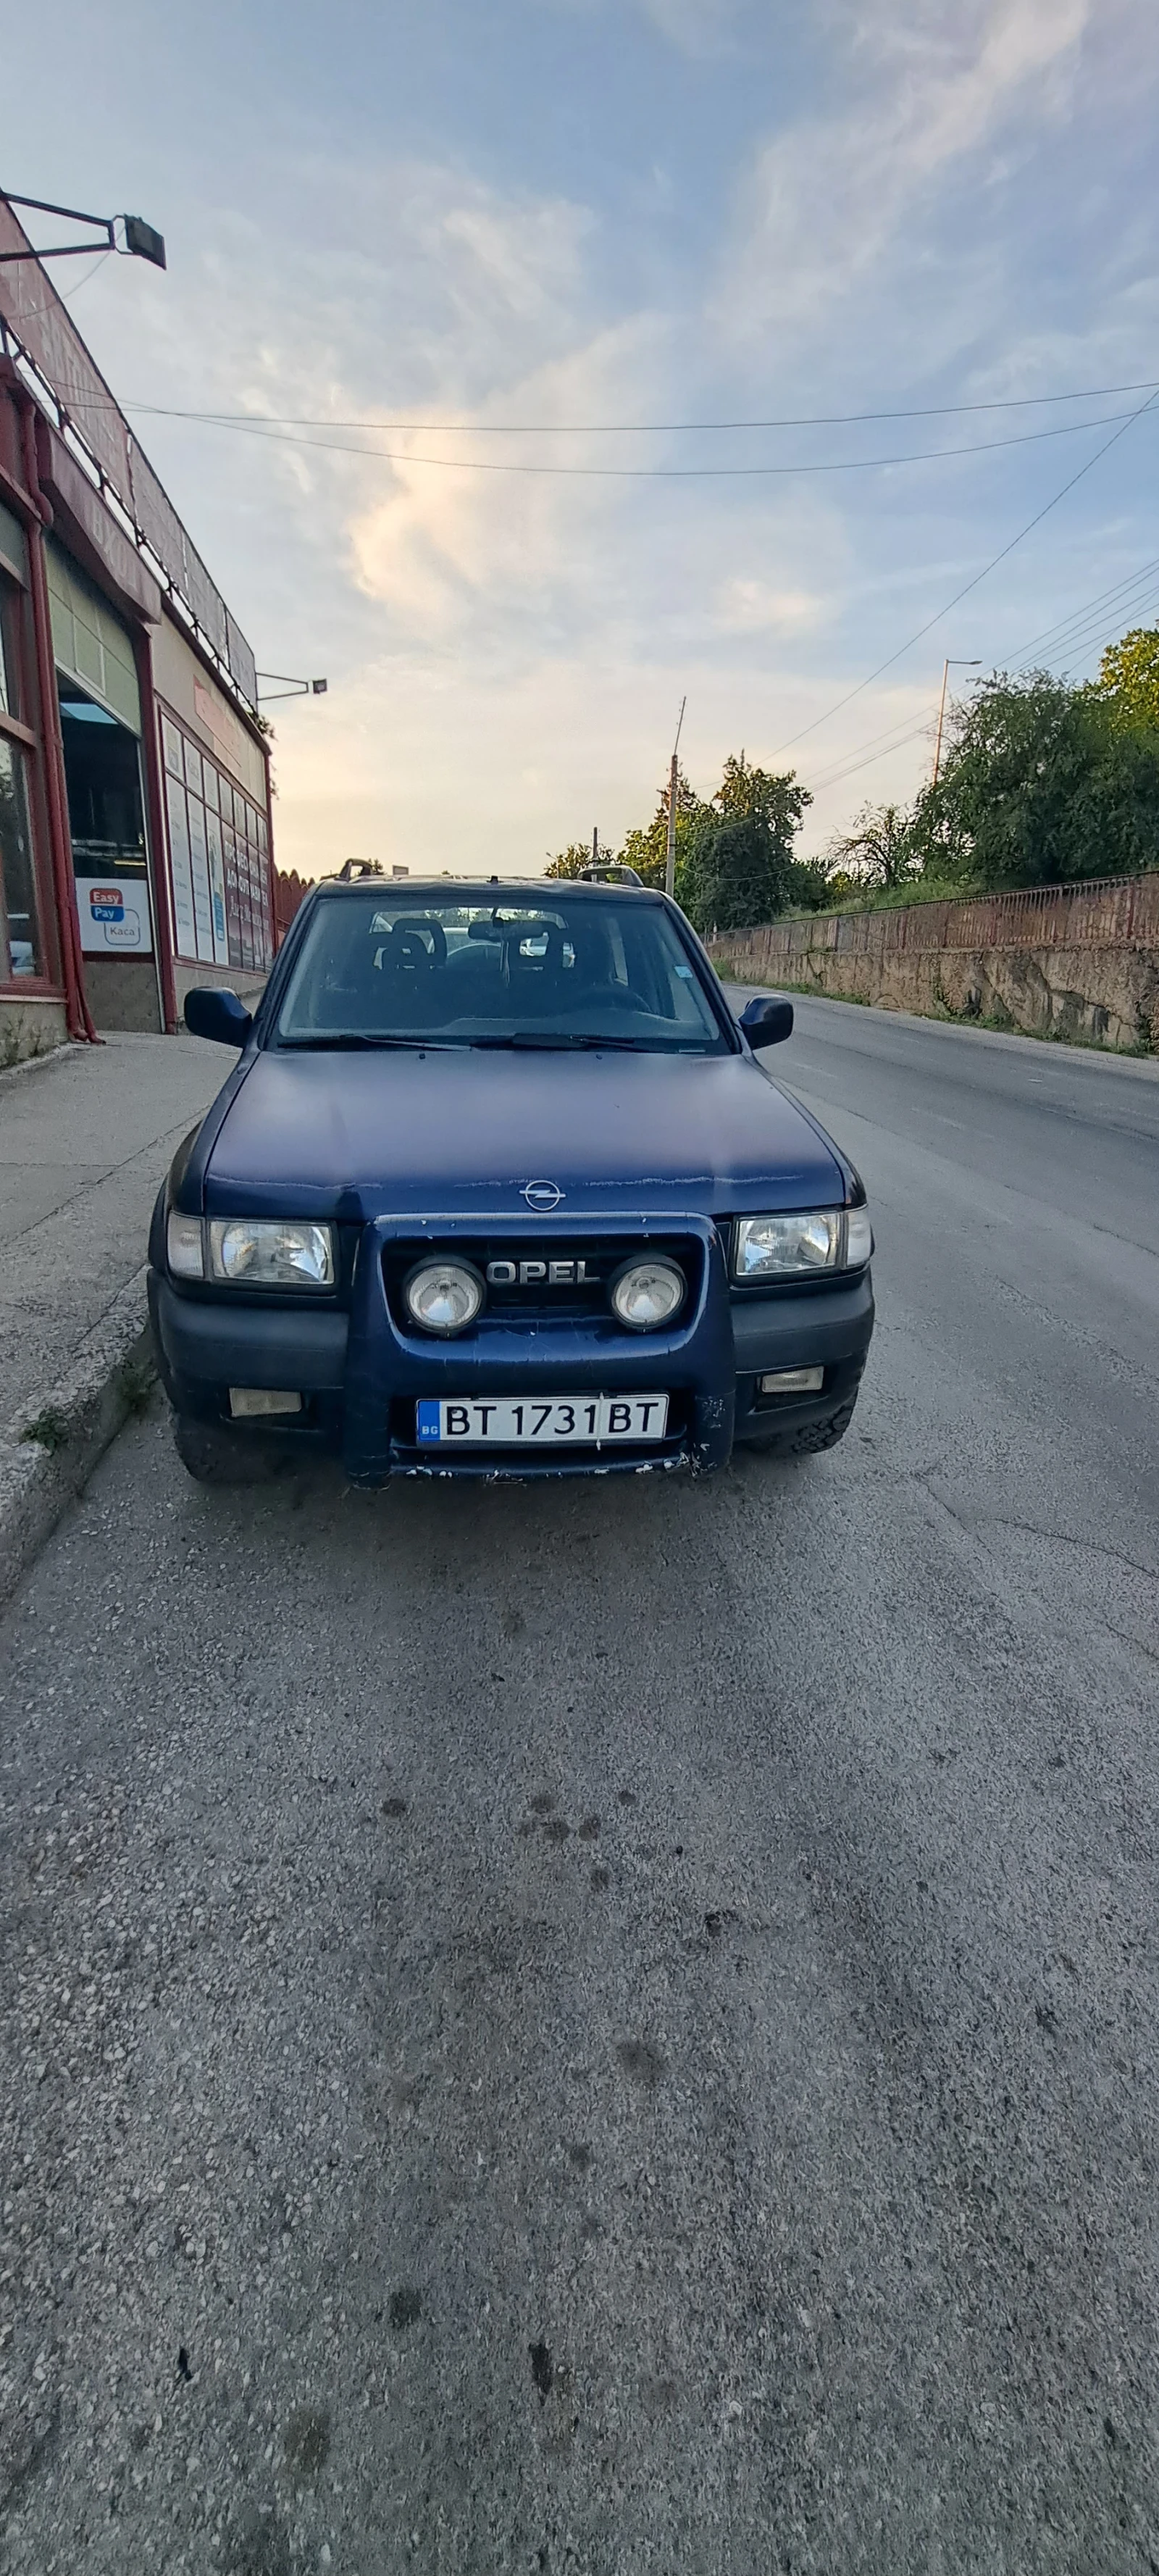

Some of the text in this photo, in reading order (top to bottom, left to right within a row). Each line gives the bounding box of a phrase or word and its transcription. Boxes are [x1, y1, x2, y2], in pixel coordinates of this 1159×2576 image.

[93, 891, 120, 905] Easy
[94, 906, 114, 920] Pay
[110, 927, 135, 936] Каса
[486, 1261, 601, 1284] OPEL
[446, 1402, 659, 1435] BT 1731 BT
[422, 1425, 438, 1435] BG
